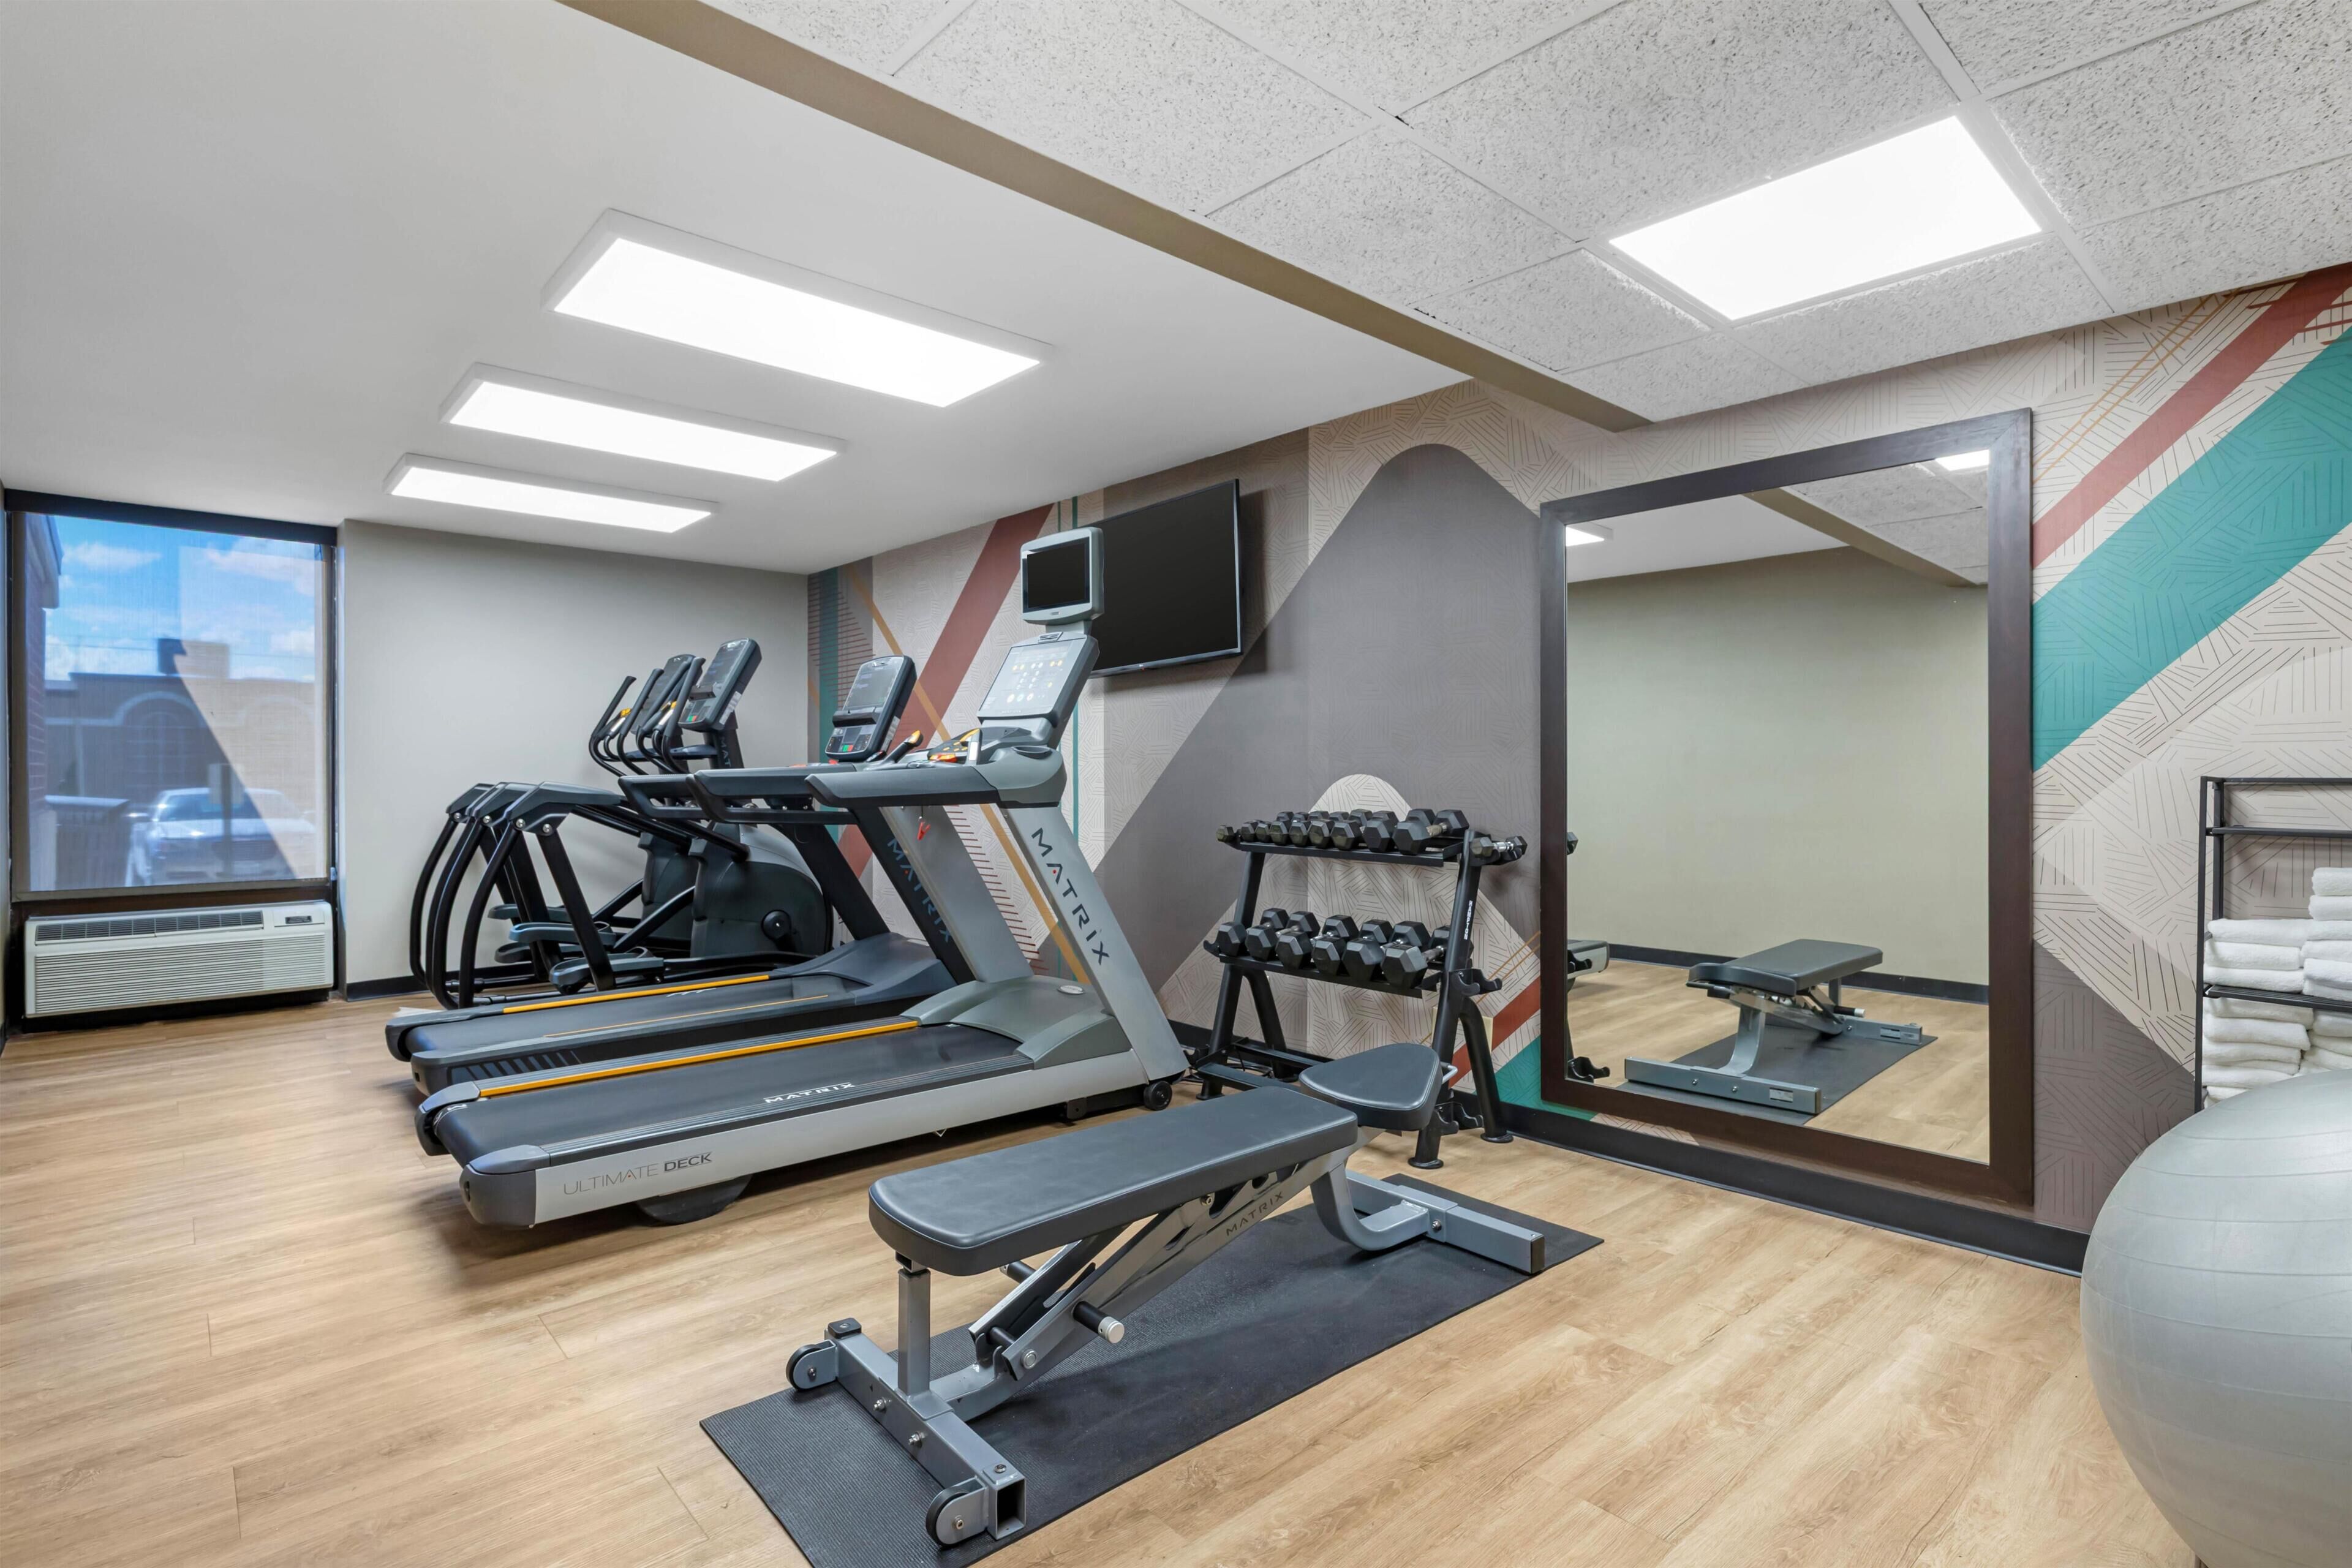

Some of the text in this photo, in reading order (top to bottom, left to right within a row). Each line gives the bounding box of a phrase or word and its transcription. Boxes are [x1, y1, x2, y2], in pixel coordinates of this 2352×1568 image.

[721, 736, 732, 768] MAT
[1031, 827, 1110, 966] MATRIX
[764, 1083, 856, 1103] MATRIX
[564, 1152, 713, 1195] ULTIMATE DECK
[1226, 1191, 1283, 1236] MATRIX
